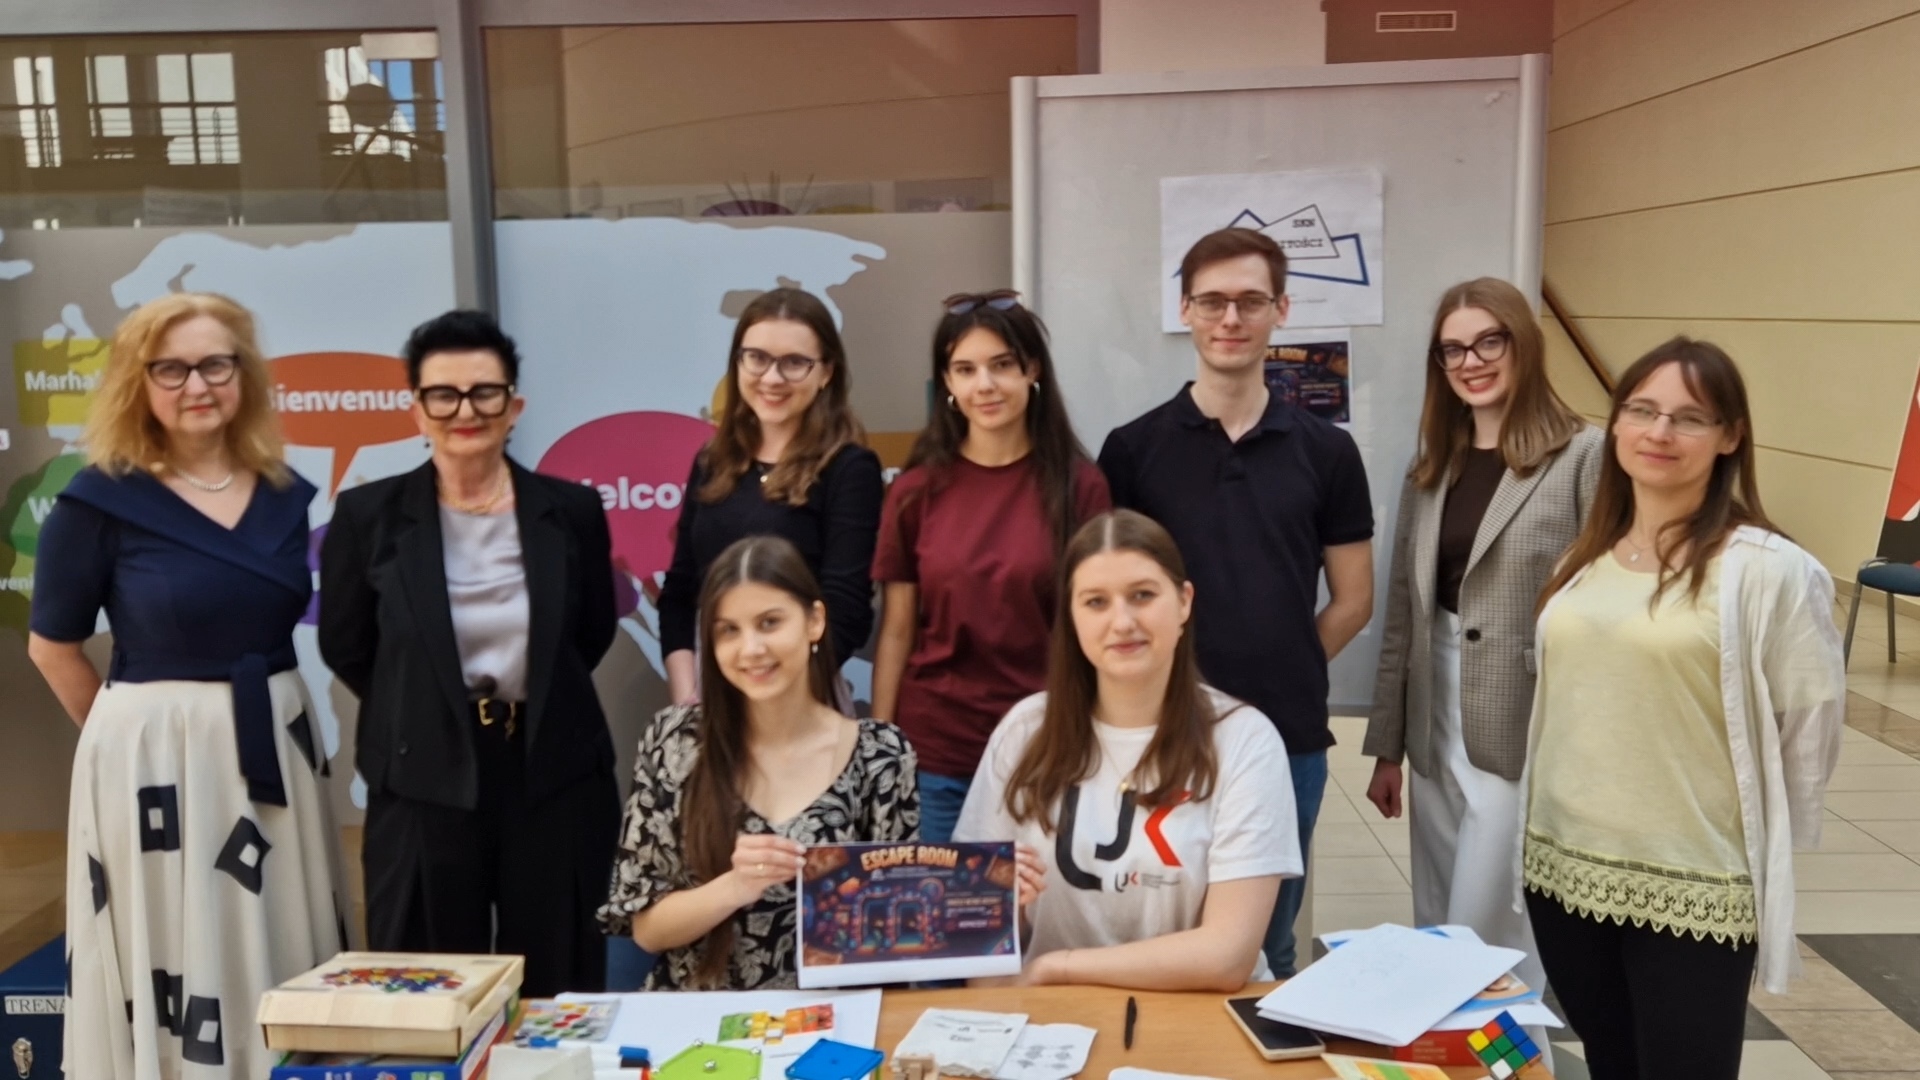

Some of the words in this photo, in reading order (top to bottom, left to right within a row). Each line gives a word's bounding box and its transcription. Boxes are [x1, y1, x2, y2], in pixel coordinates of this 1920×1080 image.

[581, 475, 687, 511] elco
[860, 845, 915, 871] ESCAPE
[917, 845, 959, 868] ROOM
